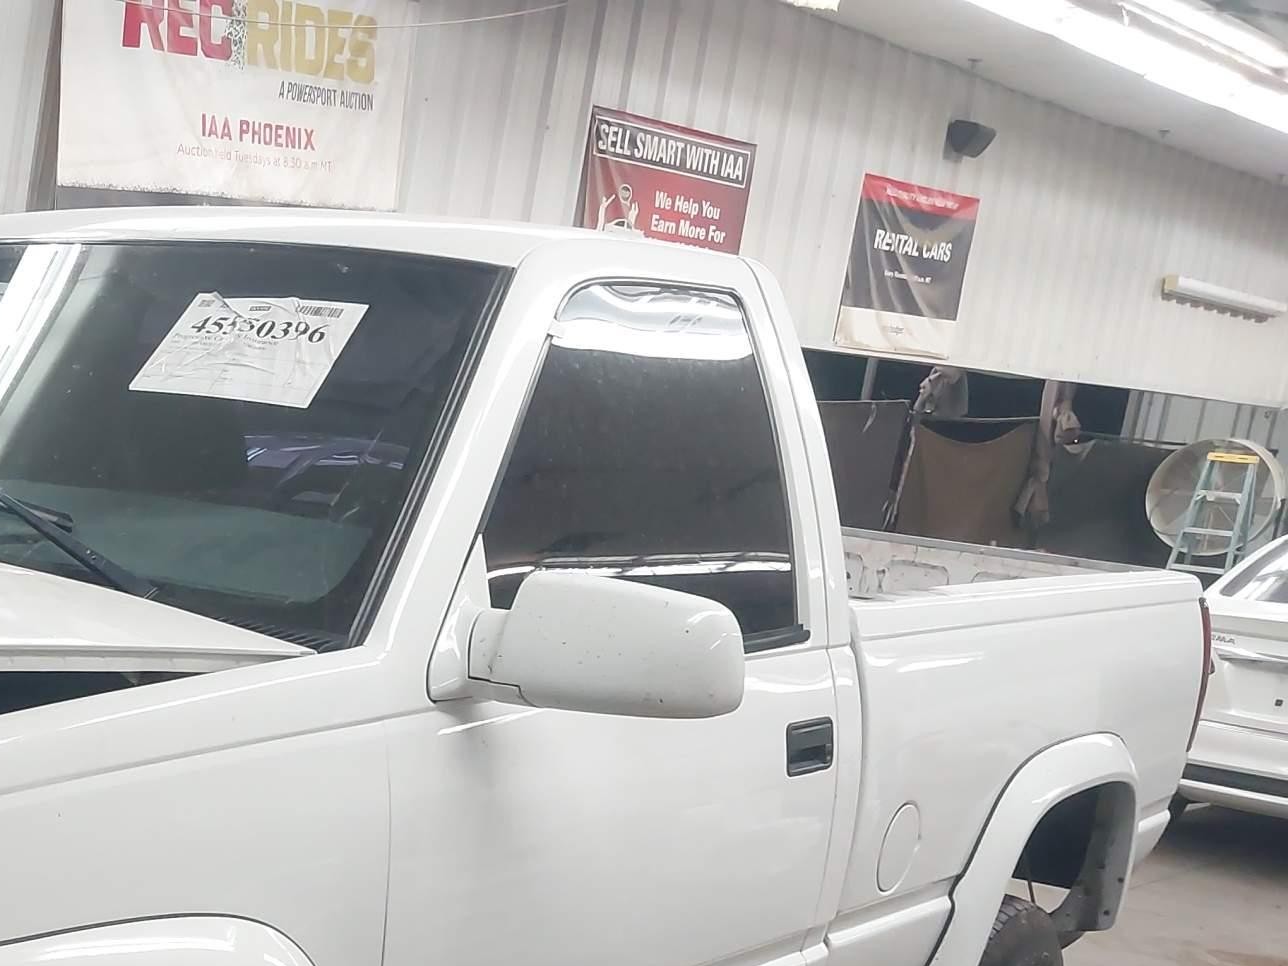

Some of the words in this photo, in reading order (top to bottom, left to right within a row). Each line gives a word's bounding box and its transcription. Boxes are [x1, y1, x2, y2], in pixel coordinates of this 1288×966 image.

[122, 0, 233, 61] REC
[247, 0, 379, 85] RIDES
[278, 80, 285, 99] A
[286, 82, 337, 107] POWERSPORT
[340, 91, 374, 112] AUCTION
[201, 113, 232, 141] IAA
[239, 119, 316, 152] PHOENIX
[598, 124, 632, 156] SELL
[634, 132, 684, 167] SMART
[686, 144, 719, 176] WITH
[720, 152, 744, 181] IAA
[654, 190, 672, 210] We
[674, 195, 699, 219] Help
[700, 199, 720, 220] You
[651, 215, 676, 235] Earn
[679, 220, 705, 240] More
[708, 225, 726, 244] For
[874, 229, 920, 257] RENTAL
[922, 240, 953, 263] CARS
